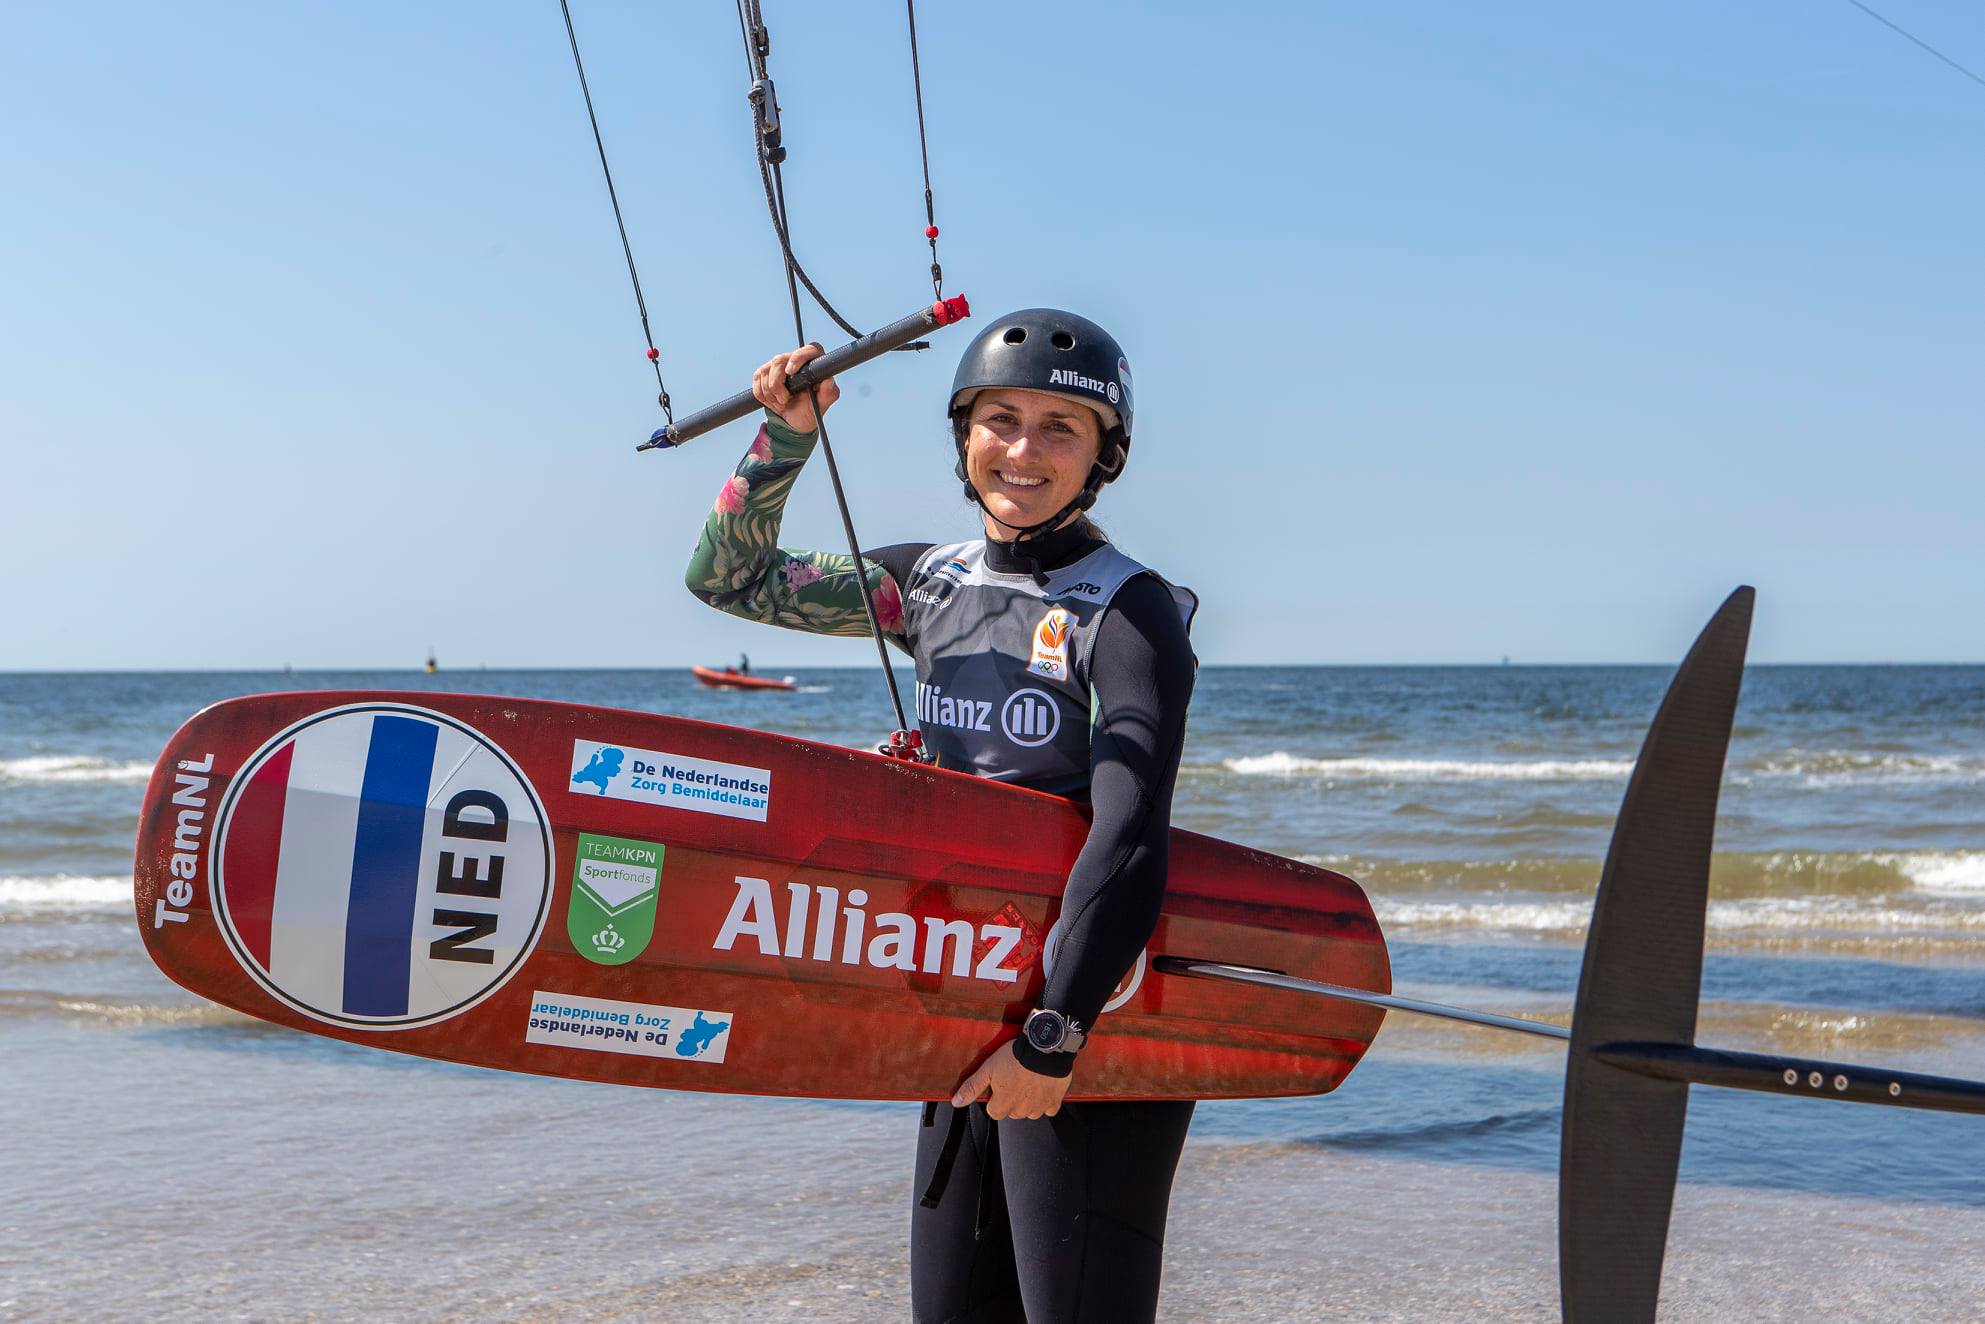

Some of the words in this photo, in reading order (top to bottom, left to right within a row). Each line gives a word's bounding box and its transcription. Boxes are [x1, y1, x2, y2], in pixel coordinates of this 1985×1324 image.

[1050, 369, 1105, 394] Allianz
[633, 760, 656, 776] De
[661, 765, 769, 794] Nederlandse
[631, 776, 666, 795] Zorg
[671, 783, 767, 809] Bemiddelaar
[155, 753, 215, 929] TeamNL
[585, 842, 656, 864] TEAMKPN
[430, 789, 509, 965] NED
[584, 865, 651, 884] Sportfonds
[712, 876, 1022, 983] Allianz
[531, 1003, 630, 1026] Bemiddelaar
[635, 1013, 672, 1031] Zorg
[529, 1018, 639, 1043] Nederlandse
[645, 1031, 668, 1046] De
